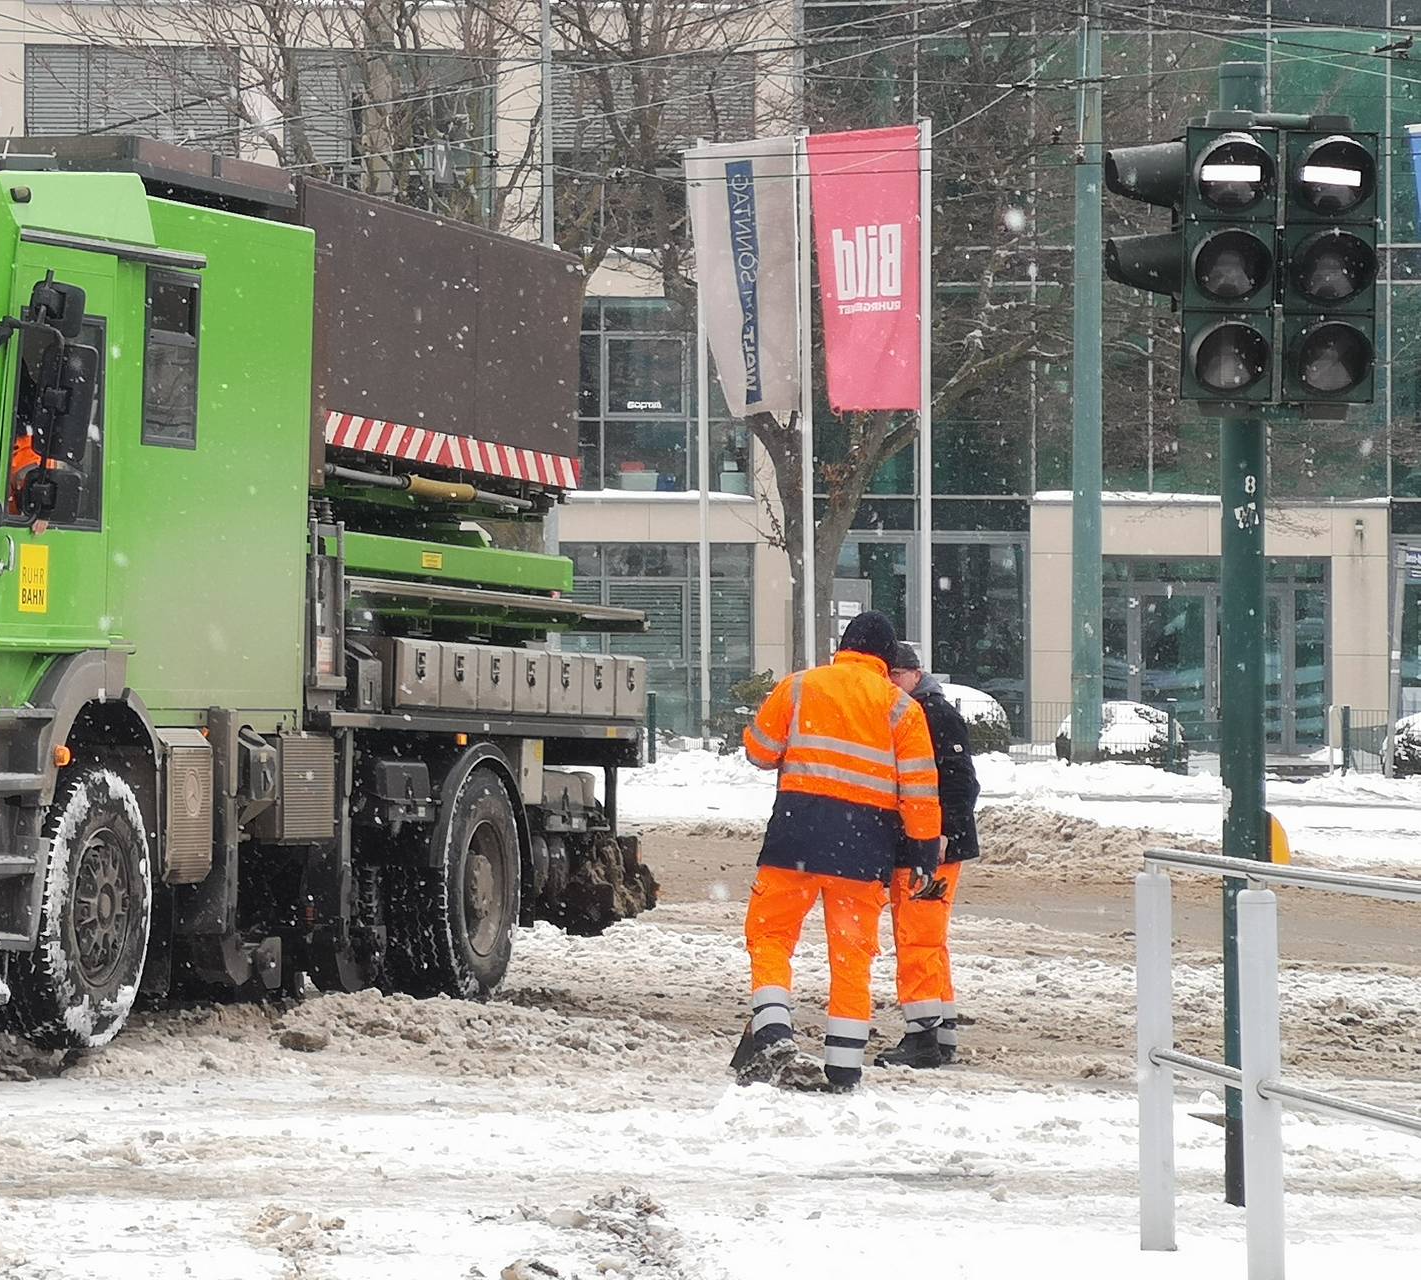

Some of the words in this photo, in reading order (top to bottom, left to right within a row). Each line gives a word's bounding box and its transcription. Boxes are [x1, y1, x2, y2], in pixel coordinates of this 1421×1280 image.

[1245, 475, 1256, 494] 8
[22, 566, 45, 585] RUHR
[22, 588, 45, 606] BAHN
